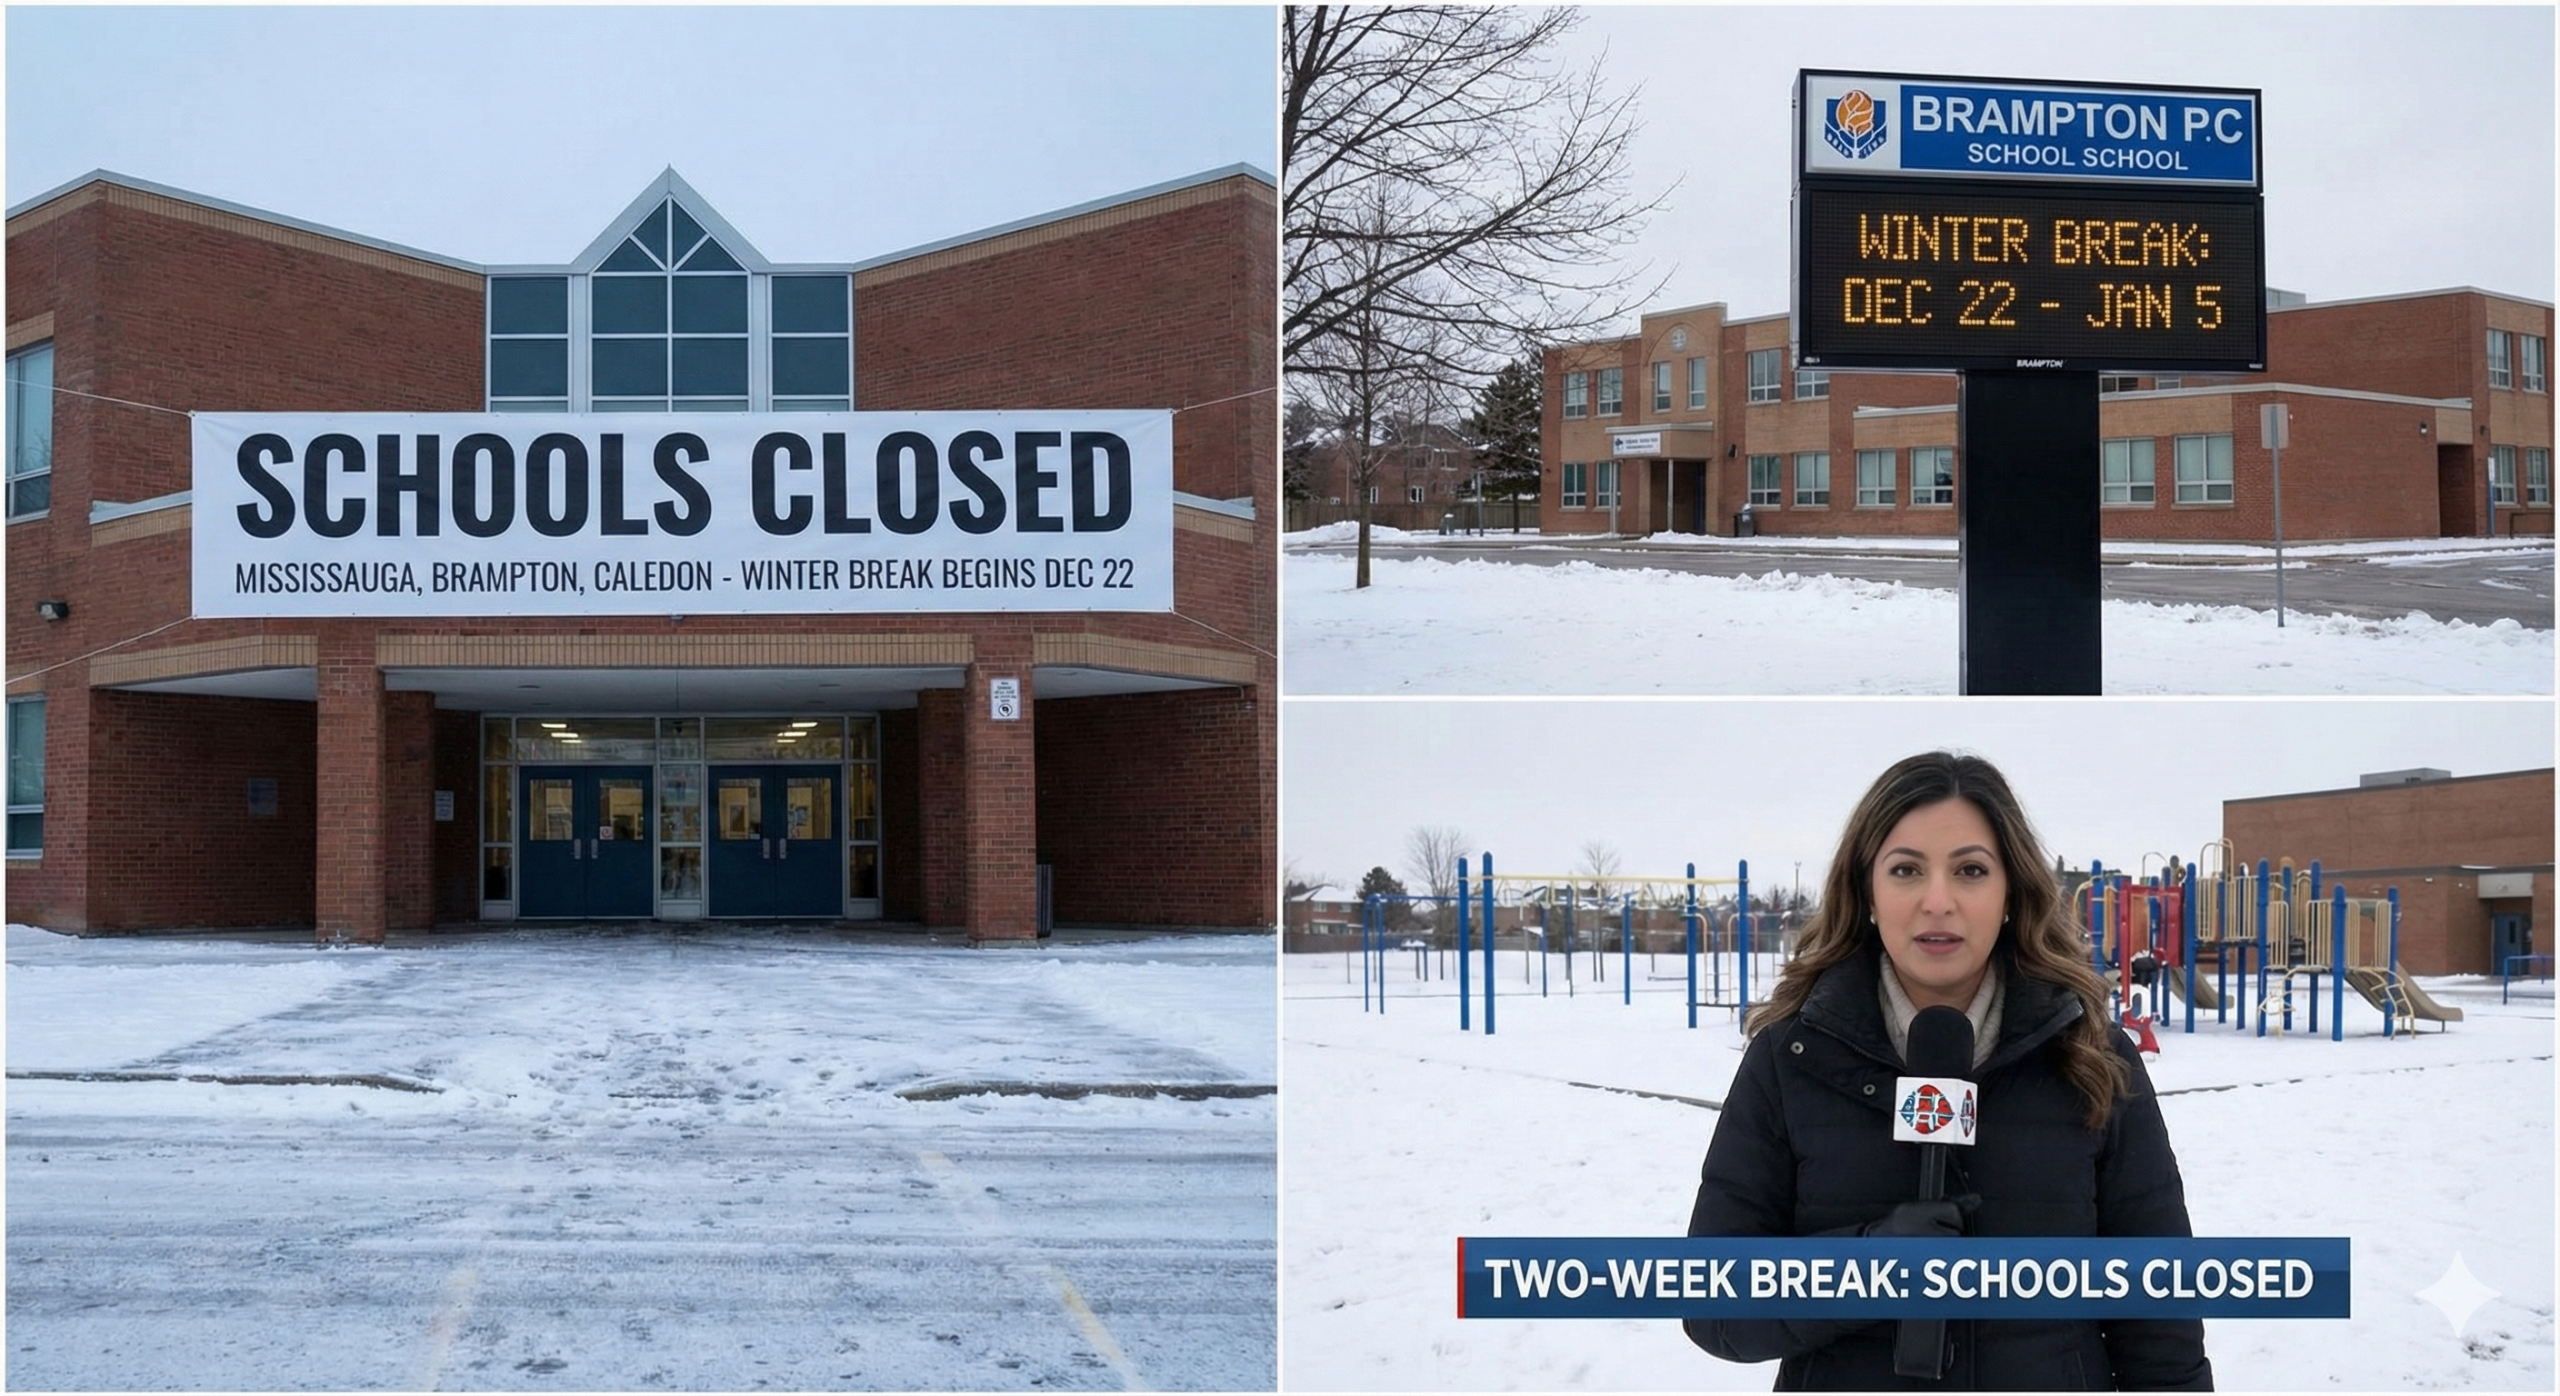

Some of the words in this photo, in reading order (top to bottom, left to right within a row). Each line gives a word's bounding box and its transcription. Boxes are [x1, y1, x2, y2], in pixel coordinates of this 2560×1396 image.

[1913, 95, 2168, 142] BRAMPTON
[2183, 106, 2244, 145] P.C
[1967, 142, 2075, 168] SCHOOL
[2082, 147, 2188, 171] SCHOOL
[1859, 213, 2029, 264] WINTER
[2054, 219, 2211, 268] BREAK:
[1843, 277, 1933, 325] DEC
[1958, 279, 2017, 327] 22
[2040, 301, 2061, 309] -
[2086, 283, 2172, 329] JAN
[2196, 285, 2222, 329] 5
[236, 432, 712, 539] SCHOOLS
[751, 430, 1133, 536] CLOSED
[235, 561, 423, 597] MISSISSAUGA,
[432, 561, 585, 597] BRAMPTON,
[594, 560, 712, 592] CALEDON
[740, 559, 840, 591] WINTER
[849, 558, 934, 590] BREAK
[942, 558, 1036, 589] BEGINS
[1044, 557, 1094, 589] DEC
[1102, 557, 1134, 589] 22
